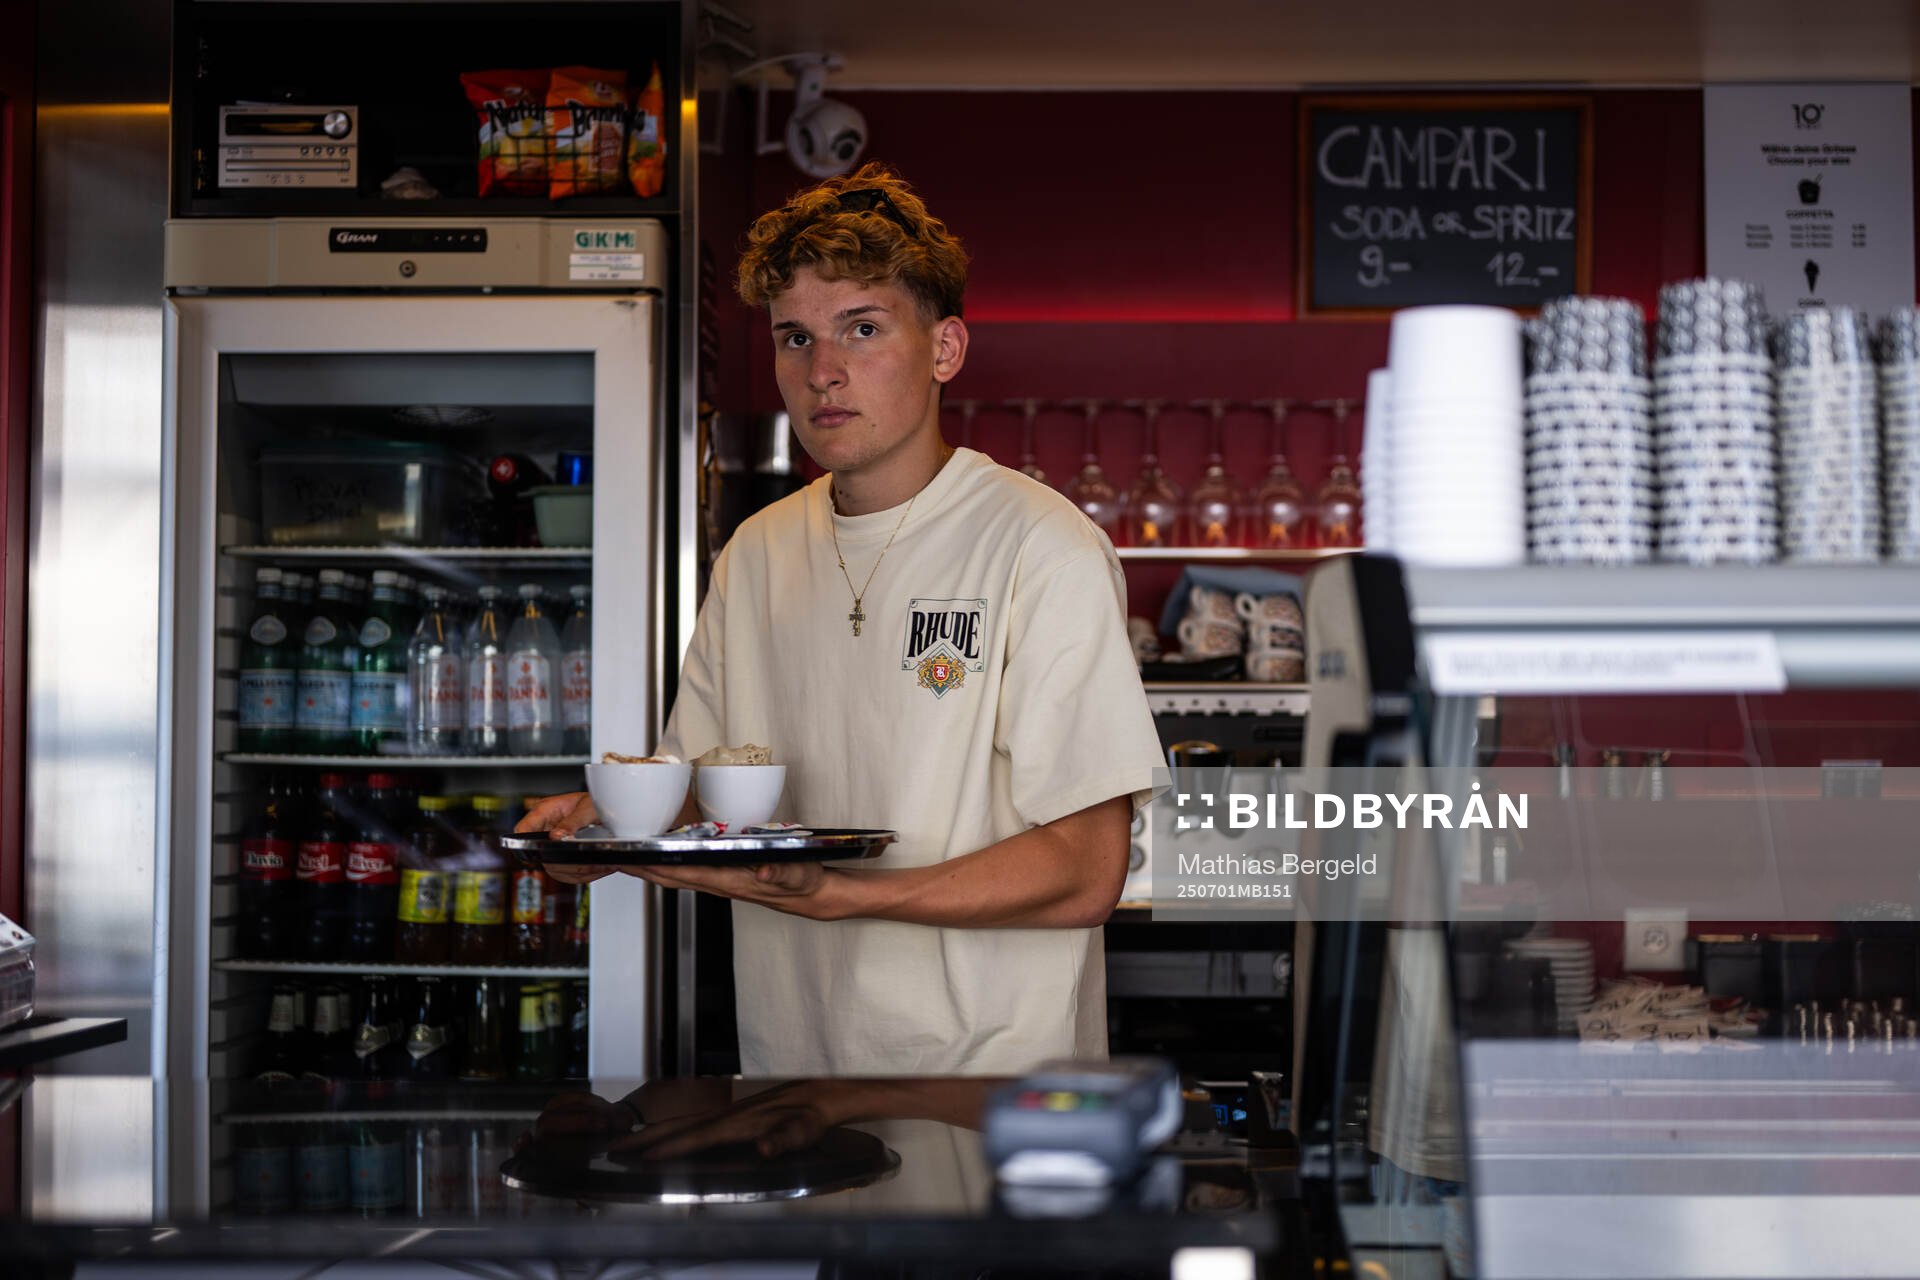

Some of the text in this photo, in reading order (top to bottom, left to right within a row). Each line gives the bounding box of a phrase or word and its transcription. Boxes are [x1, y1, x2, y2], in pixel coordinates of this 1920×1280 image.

[1318, 124, 1547, 190] CAMPARI
[1330, 203, 1427, 241] SODA
[1466, 204, 1576, 242] SPRITZ
[907, 611, 981, 659] RHUDE
